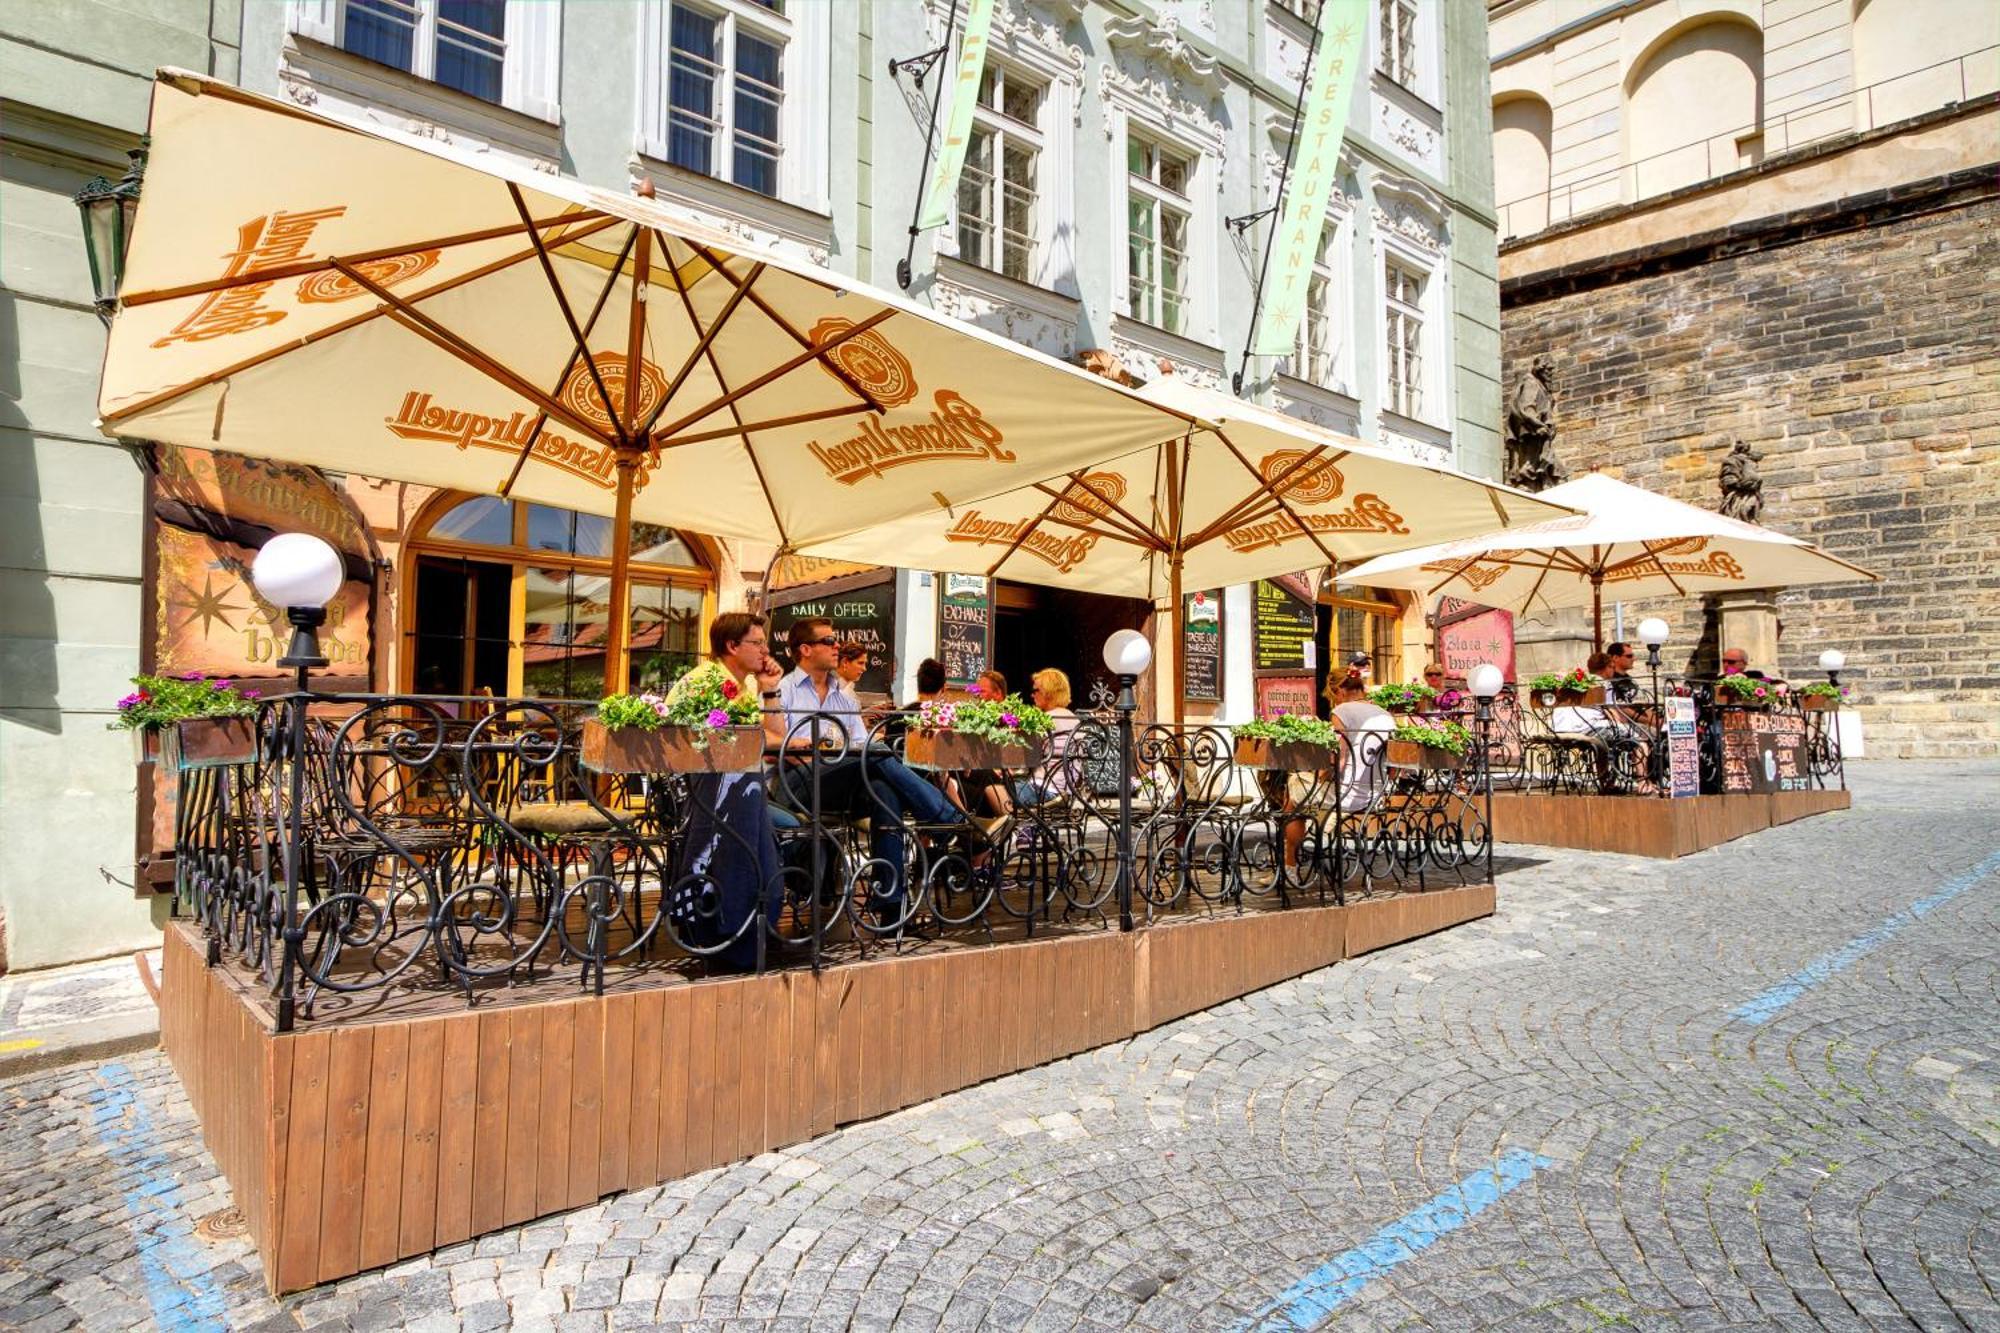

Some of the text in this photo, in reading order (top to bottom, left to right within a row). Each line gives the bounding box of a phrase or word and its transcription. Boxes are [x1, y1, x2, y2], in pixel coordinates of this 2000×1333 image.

[1284, 58, 1345, 292] RESTAURANT
[791, 602, 878, 618] DAILY OFFER
[847, 628, 880, 643] AFRICA
